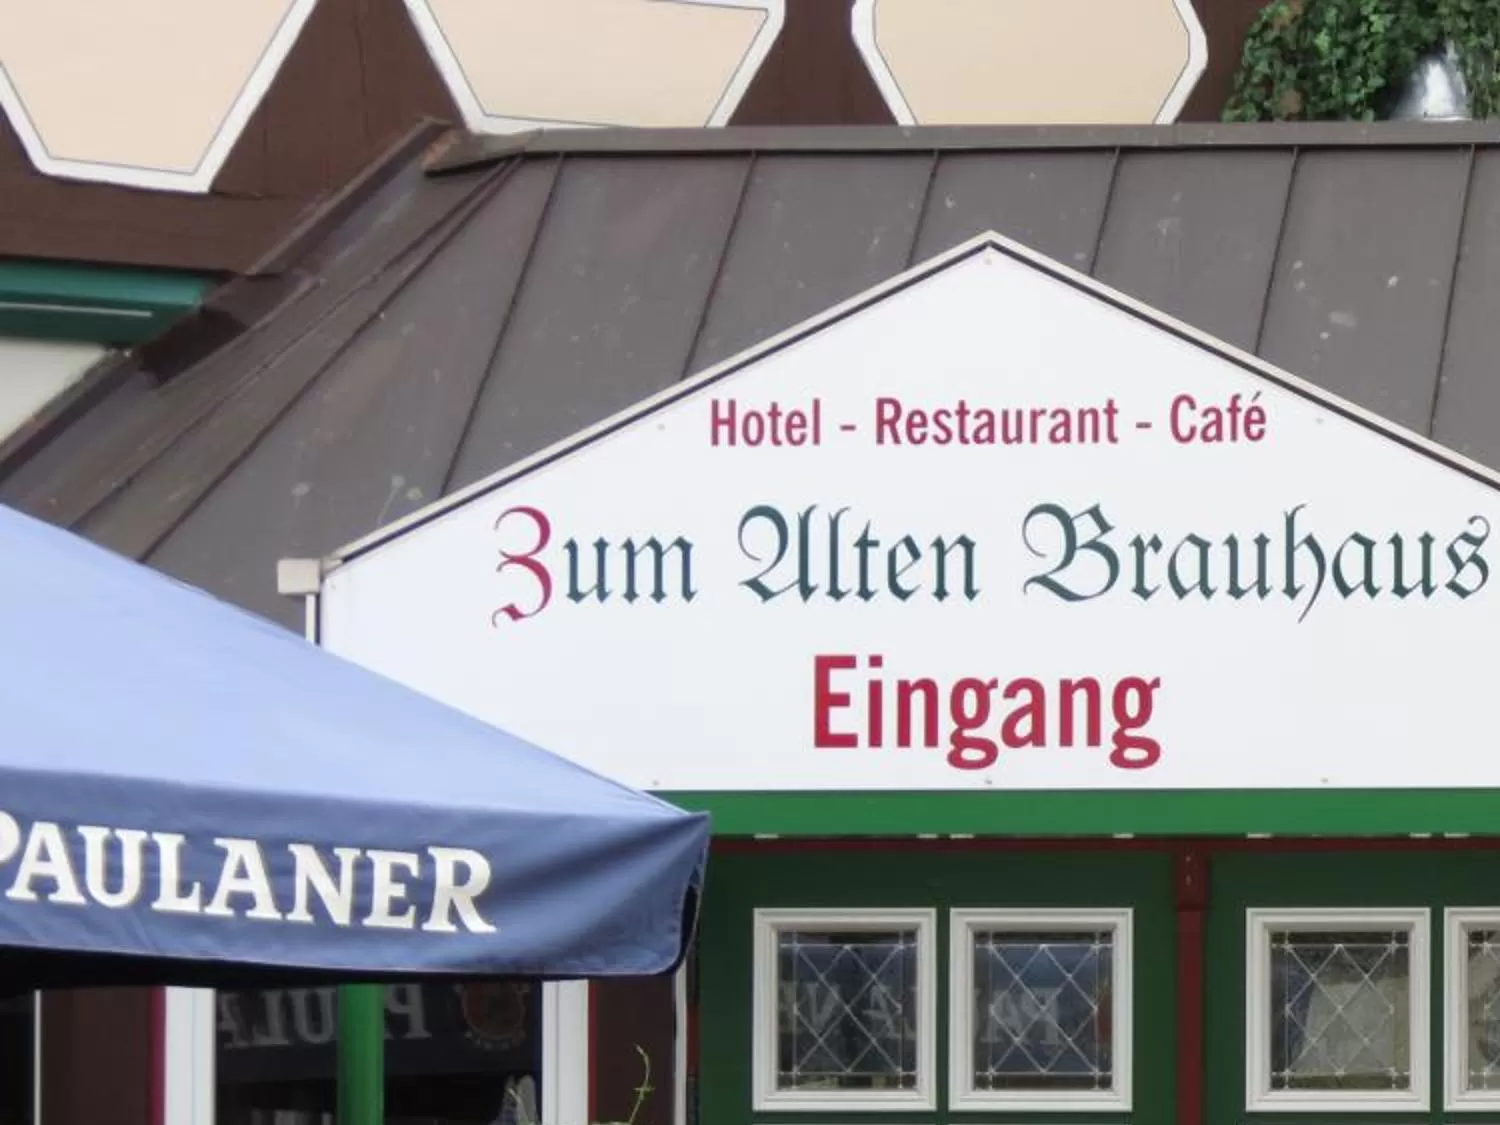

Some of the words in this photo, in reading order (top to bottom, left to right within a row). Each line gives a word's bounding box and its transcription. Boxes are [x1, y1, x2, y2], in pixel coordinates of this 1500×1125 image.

[710, 398, 821, 446] Hotel
[875, 397, 1119, 446] Restaurant
[1169, 392, 1267, 444] Café
[491, 506, 697, 627] Zum
[737, 504, 980, 603] Alten
[1022, 502, 1491, 623] Brauhaus
[812, 654, 1162, 770] Eingang
[0, 810, 497, 934] AULANER
